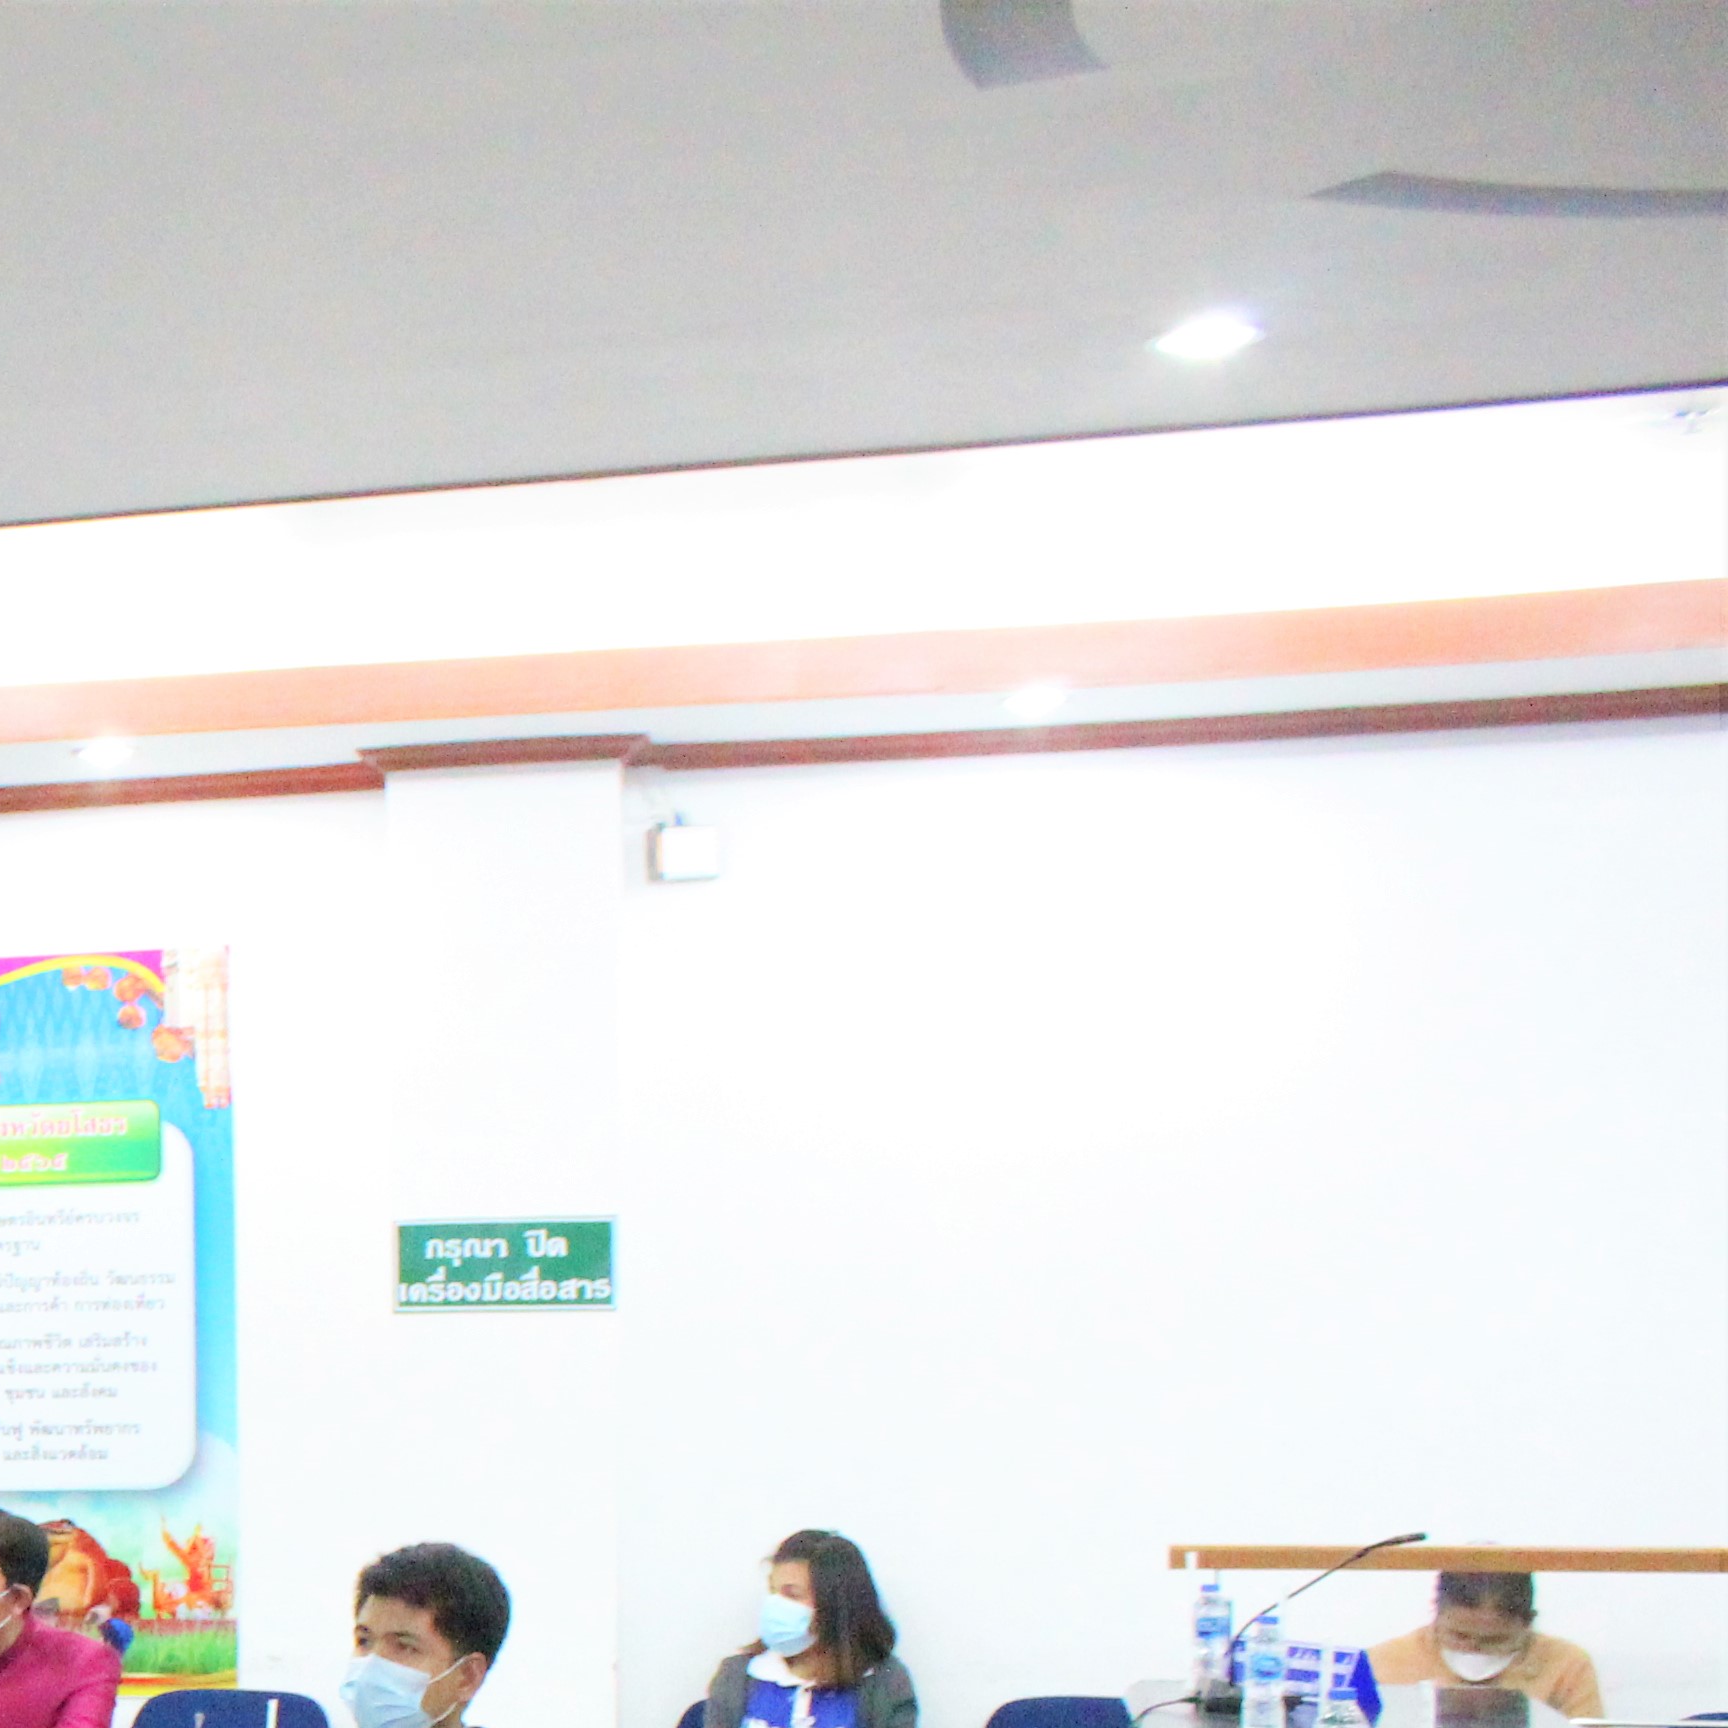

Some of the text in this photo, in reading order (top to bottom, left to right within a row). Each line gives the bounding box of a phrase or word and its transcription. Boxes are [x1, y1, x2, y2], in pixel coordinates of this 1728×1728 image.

[424, 1228, 569, 1267] กรุณา ปิด
[398, 1265, 611, 1303] เครื่องมือสื่อสาร
